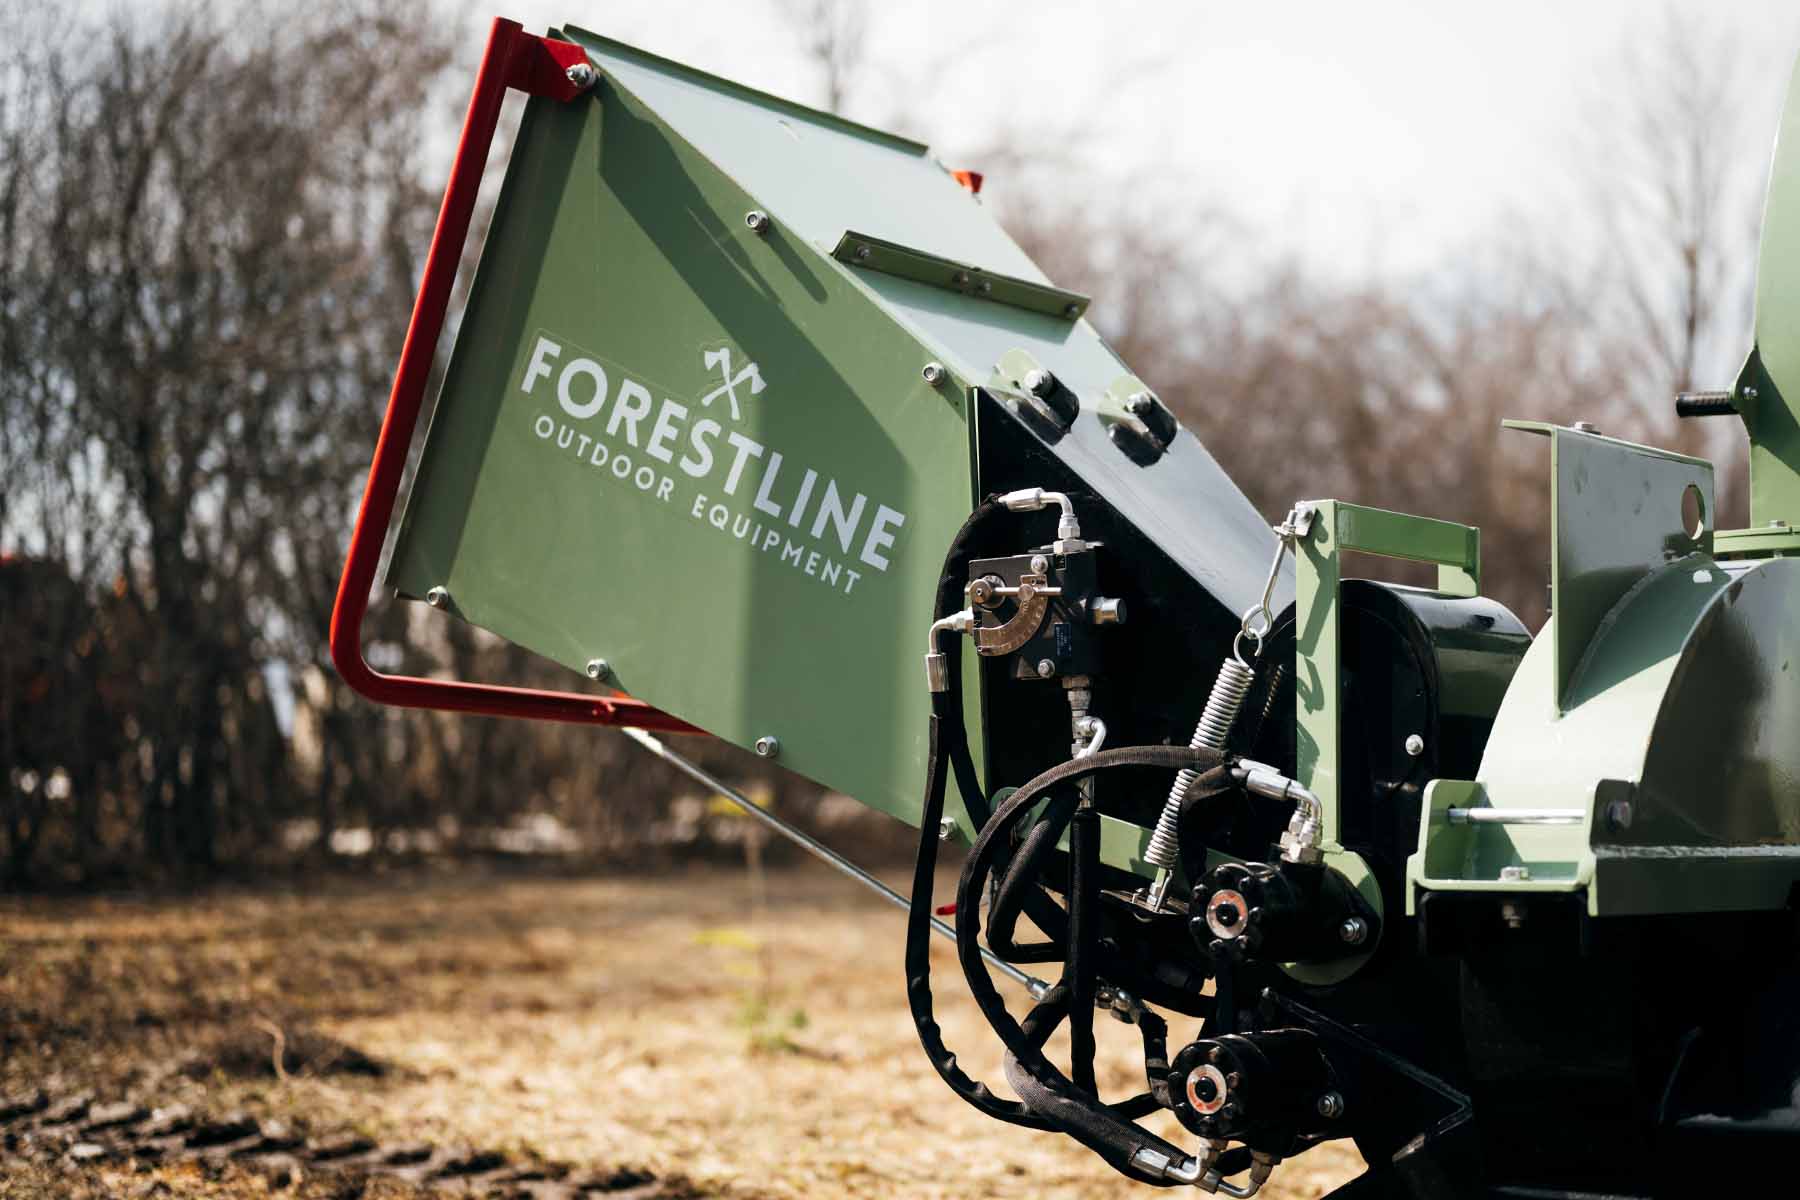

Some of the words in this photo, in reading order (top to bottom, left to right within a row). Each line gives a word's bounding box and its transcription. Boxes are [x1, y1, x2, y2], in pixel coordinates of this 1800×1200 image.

[521, 337, 905, 571] FORESTLINE
[535, 415, 675, 501] OUTDOOR
[691, 494, 861, 594] EQUIPMENT
